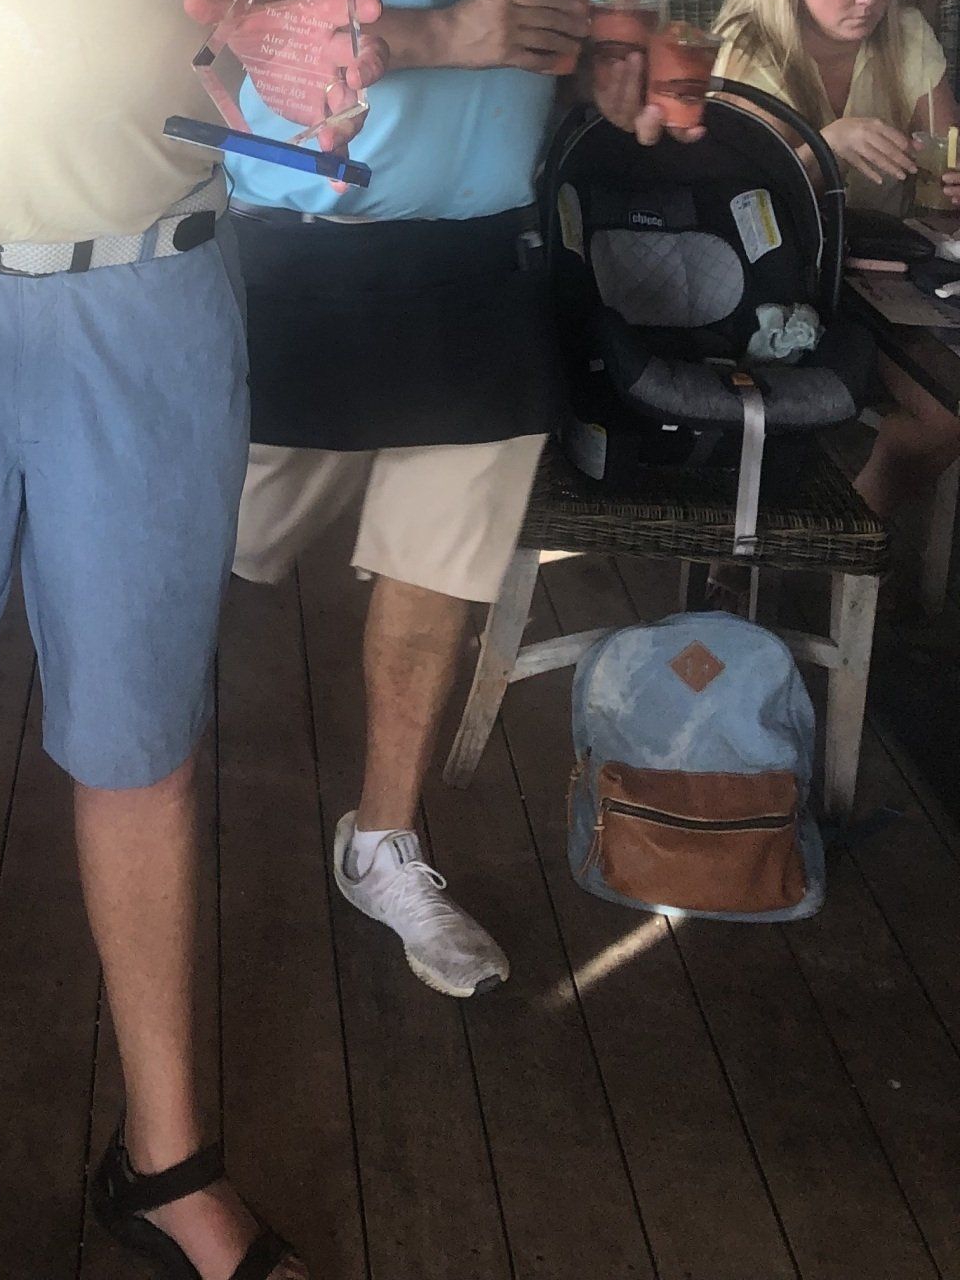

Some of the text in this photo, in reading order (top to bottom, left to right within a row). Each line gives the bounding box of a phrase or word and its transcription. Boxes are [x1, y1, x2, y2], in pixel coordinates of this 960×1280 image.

[266, 8, 333, 30] The Big Kahuna
[282, 23, 310, 36] Award
[263, 33, 284, 45] Aire
[304, 53, 321, 65] DE
[256, 79, 287, 96] Dynamic
